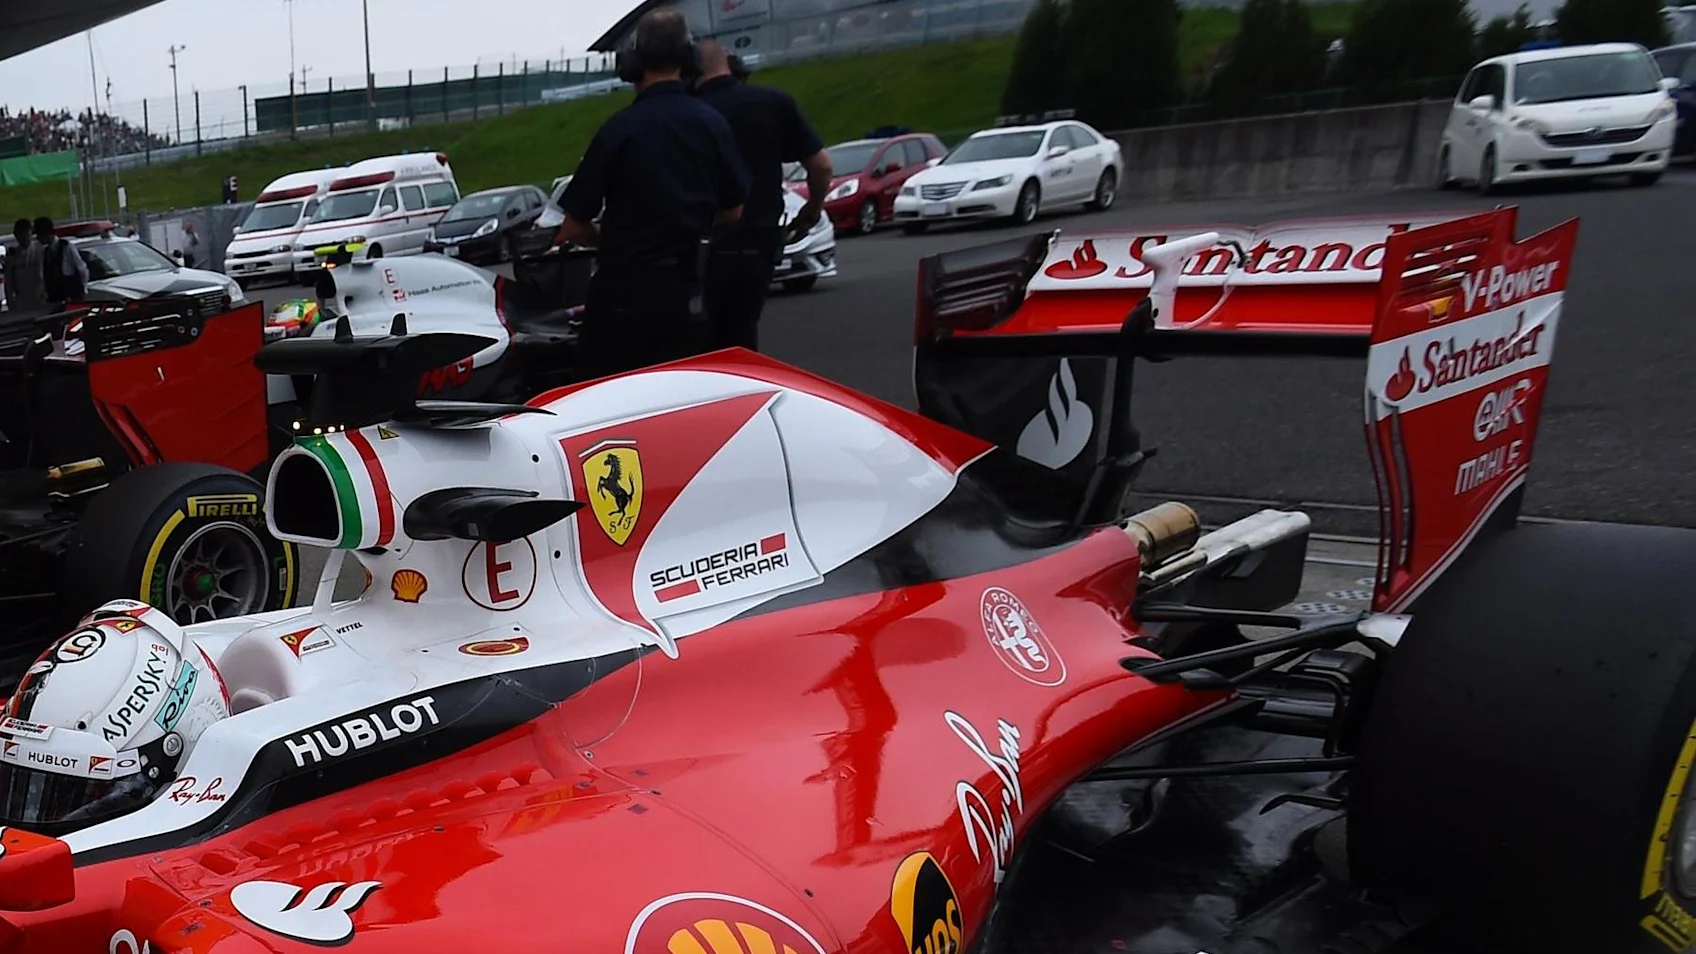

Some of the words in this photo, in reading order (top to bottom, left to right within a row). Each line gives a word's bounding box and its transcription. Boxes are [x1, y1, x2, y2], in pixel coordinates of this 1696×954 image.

[385, 269, 396, 284] E
[1463, 260, 1560, 313] V-Power
[1418, 310, 1548, 392] Santander
[186, 493, 258, 518] PIRELLI
[650, 543, 759, 587] SCUDERIA
[701, 552, 790, 590] FERRARI
[336, 621, 364, 635] VETTEL
[151, 643, 169, 656] lab
[163, 670, 196, 729] Riva
[285, 697, 440, 767] HUBLOT
[28, 751, 78, 768] HUBLOT
